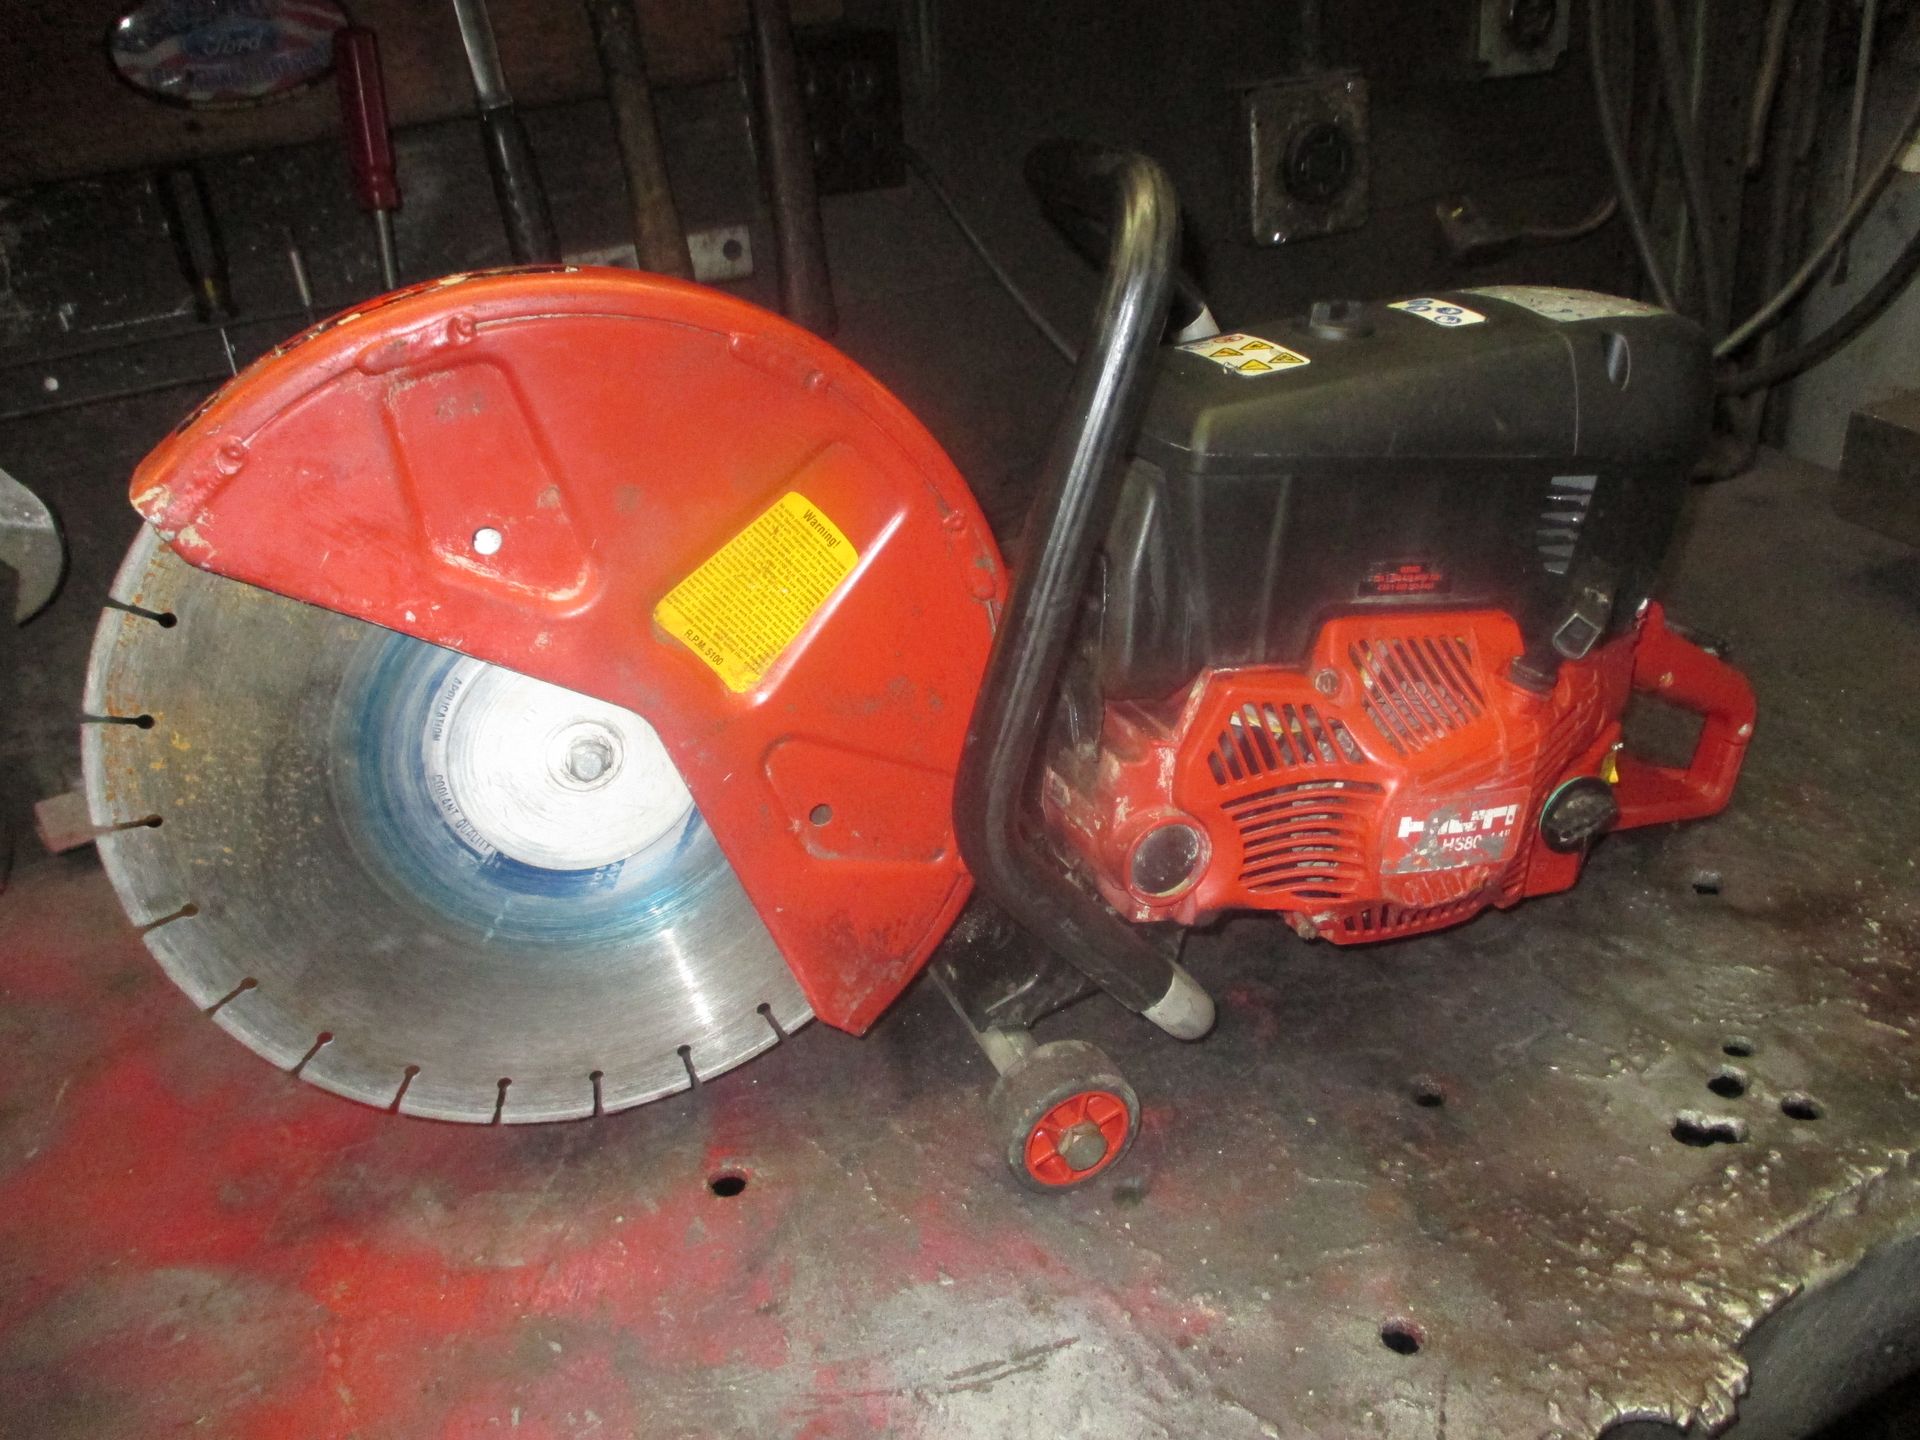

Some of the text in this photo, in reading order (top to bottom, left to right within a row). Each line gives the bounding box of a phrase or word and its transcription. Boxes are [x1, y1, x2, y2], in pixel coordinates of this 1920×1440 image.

[803, 509, 841, 548] Warning!
[685, 629, 724, 666] R.P.M. 5100
[456, 817, 491, 852] QUALITY
